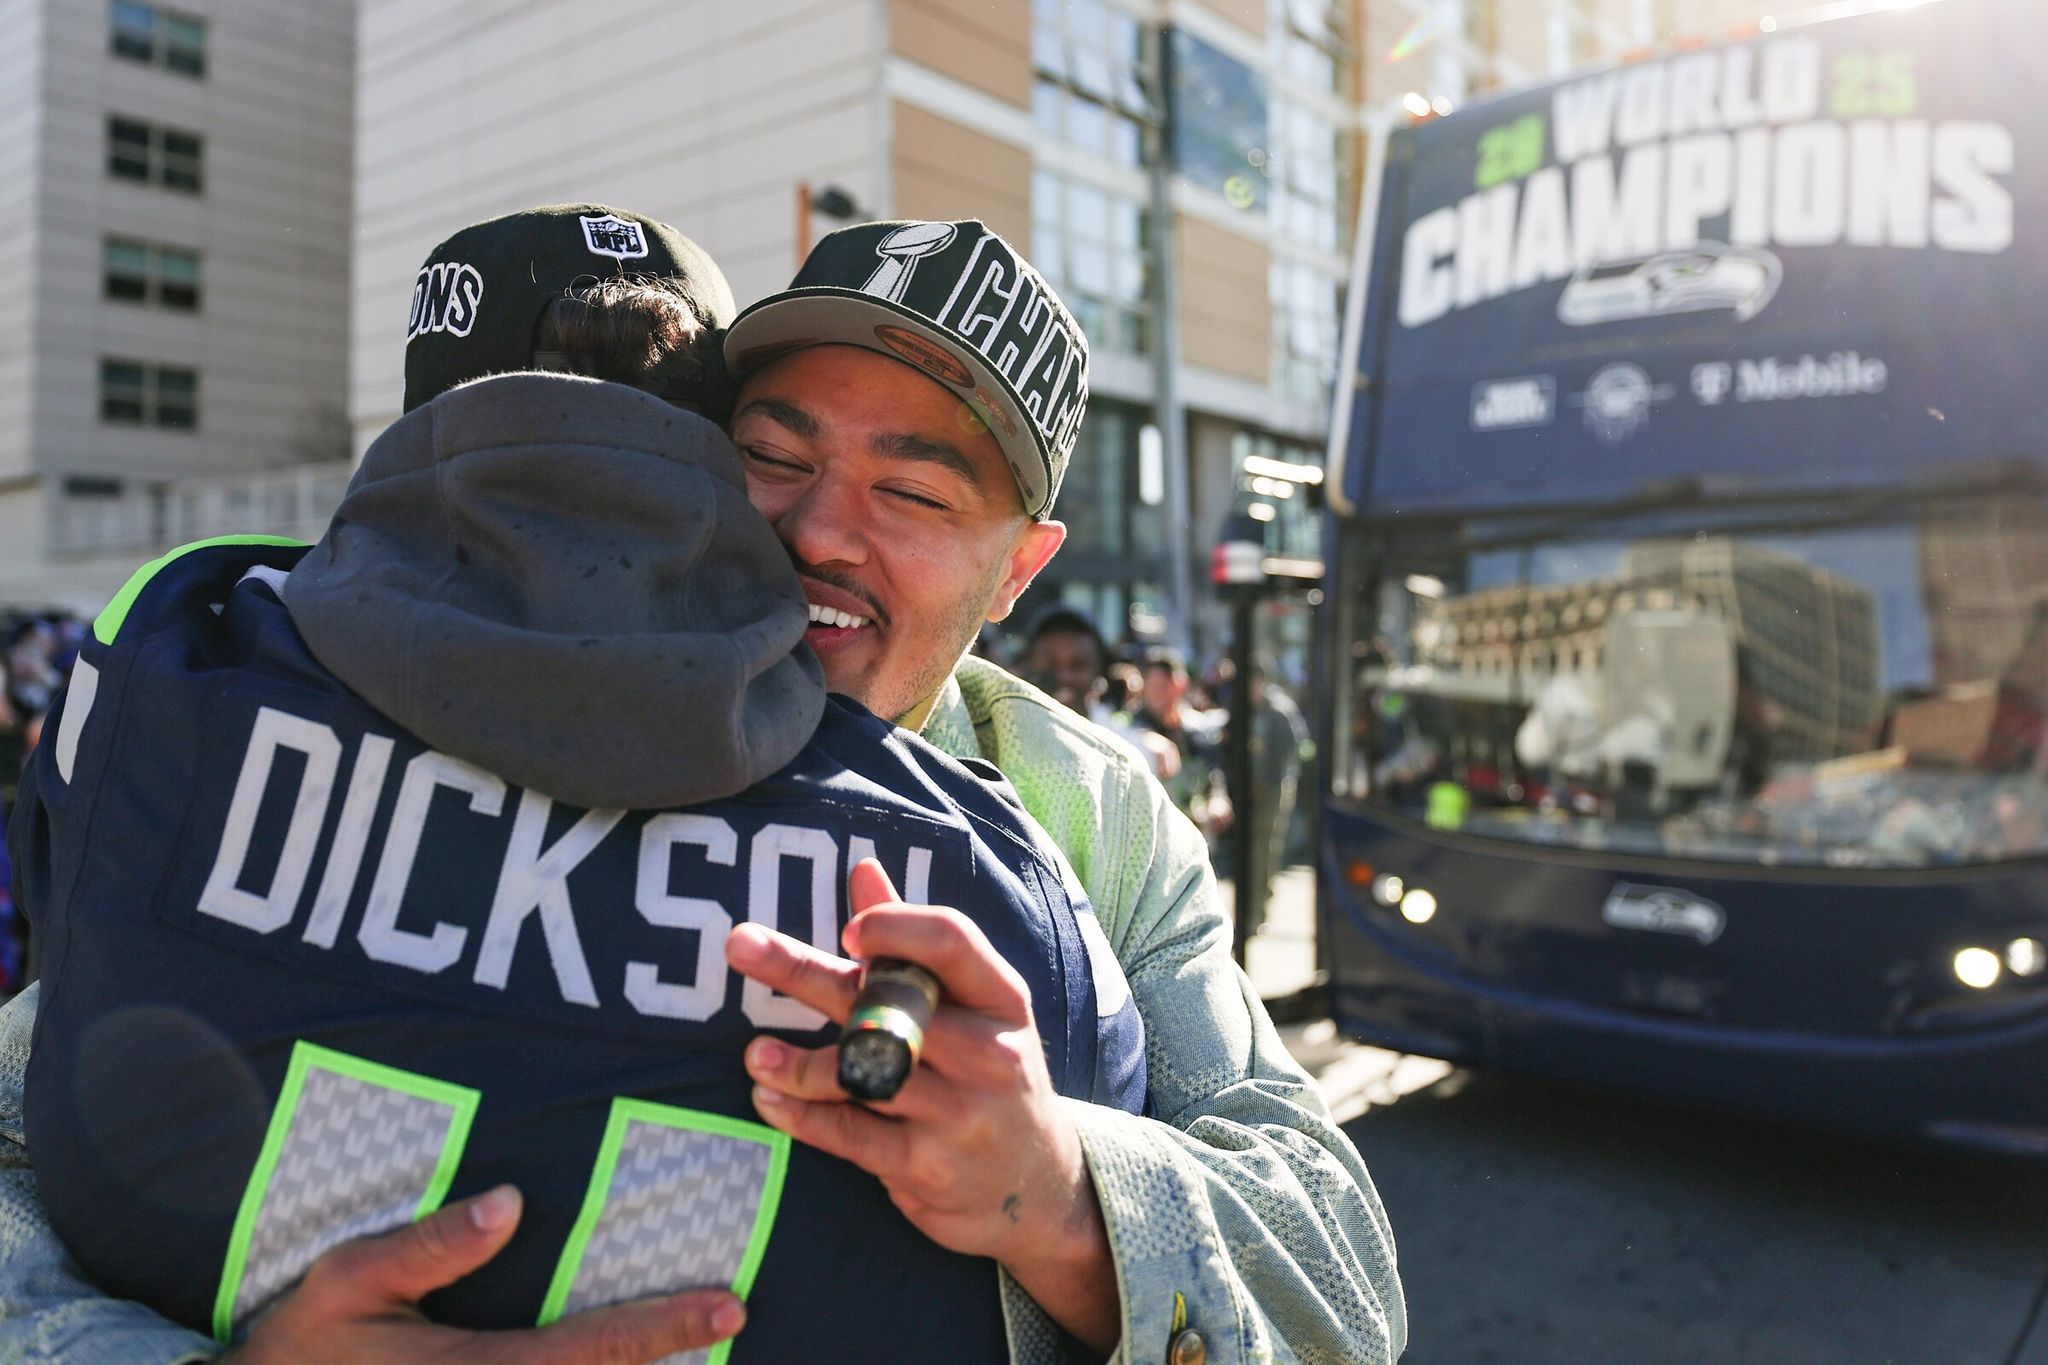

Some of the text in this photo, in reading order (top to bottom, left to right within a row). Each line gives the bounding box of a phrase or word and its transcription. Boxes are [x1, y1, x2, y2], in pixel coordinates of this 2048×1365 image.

[1551, 36, 1821, 165] WORLD
[1831, 50, 1919, 118] 25
[1397, 118, 2015, 329] CHAMPIONS
[1737, 350, 1888, 402] Mobile
